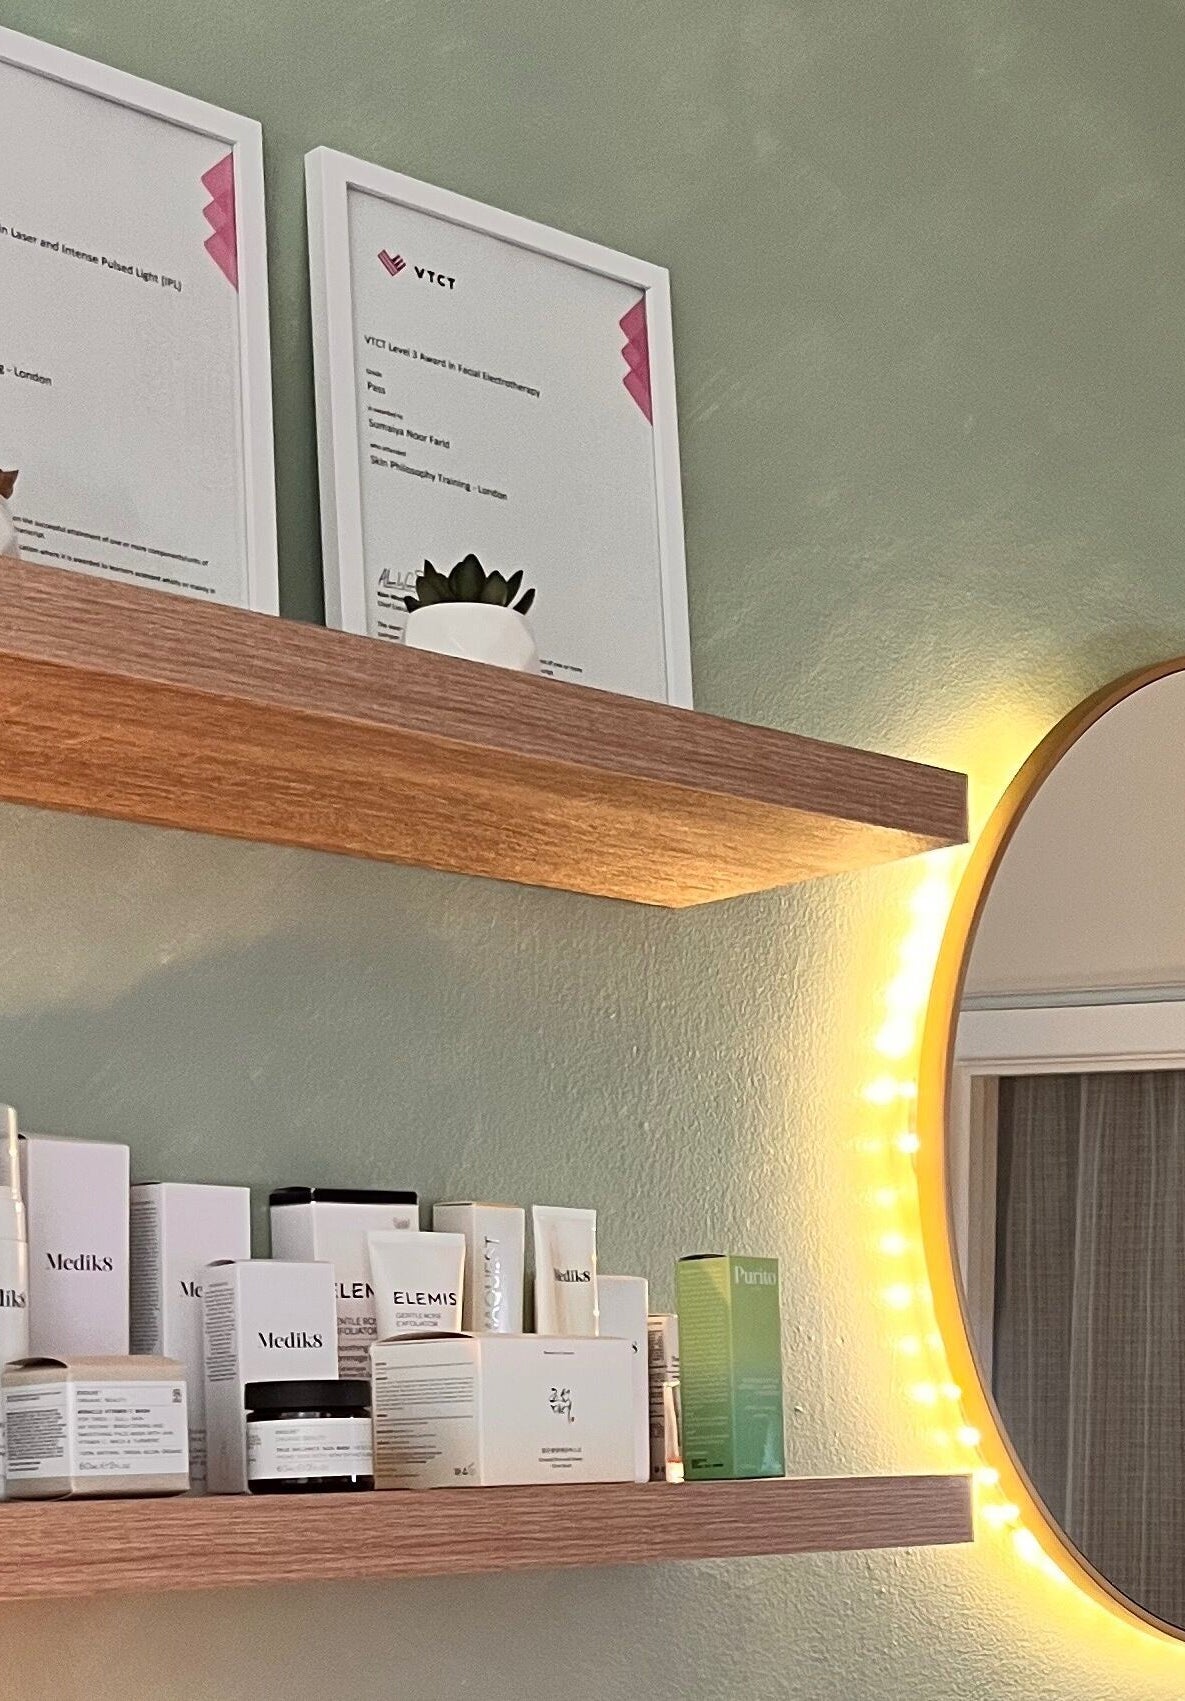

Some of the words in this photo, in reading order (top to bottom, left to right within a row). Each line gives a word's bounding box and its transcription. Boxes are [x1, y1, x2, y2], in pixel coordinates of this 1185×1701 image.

[11, 228, 37, 243] Laser
[40, 238, 59, 252] and
[62, 245, 99, 265] Intense
[101, 257, 133, 276] Pulsed
[136, 267, 159, 283] Light
[414, 265, 456, 289] VTCT
[14, 366, 52, 386] London
[364, 335, 386, 349] VTCT
[388, 342, 410, 358] Level
[420, 353, 446, 369] Award
[458, 364, 481, 379] Facial
[482, 371, 541, 399] Electrotherapy
[367, 381, 387, 395] Pass
[406, 429, 428, 442] Noor
[429, 435, 450, 449] Farid
[370, 455, 389, 468] Skin
[390, 460, 436, 482] Philosophy
[438, 473, 471, 493] Training
[478, 485, 507, 500] London
[46, 1252, 113, 1272] Medik8
[734, 1265, 776, 1285] Purito
[393, 1291, 457, 1306] ELEMIS
[258, 1331, 323, 1350] Medik8
